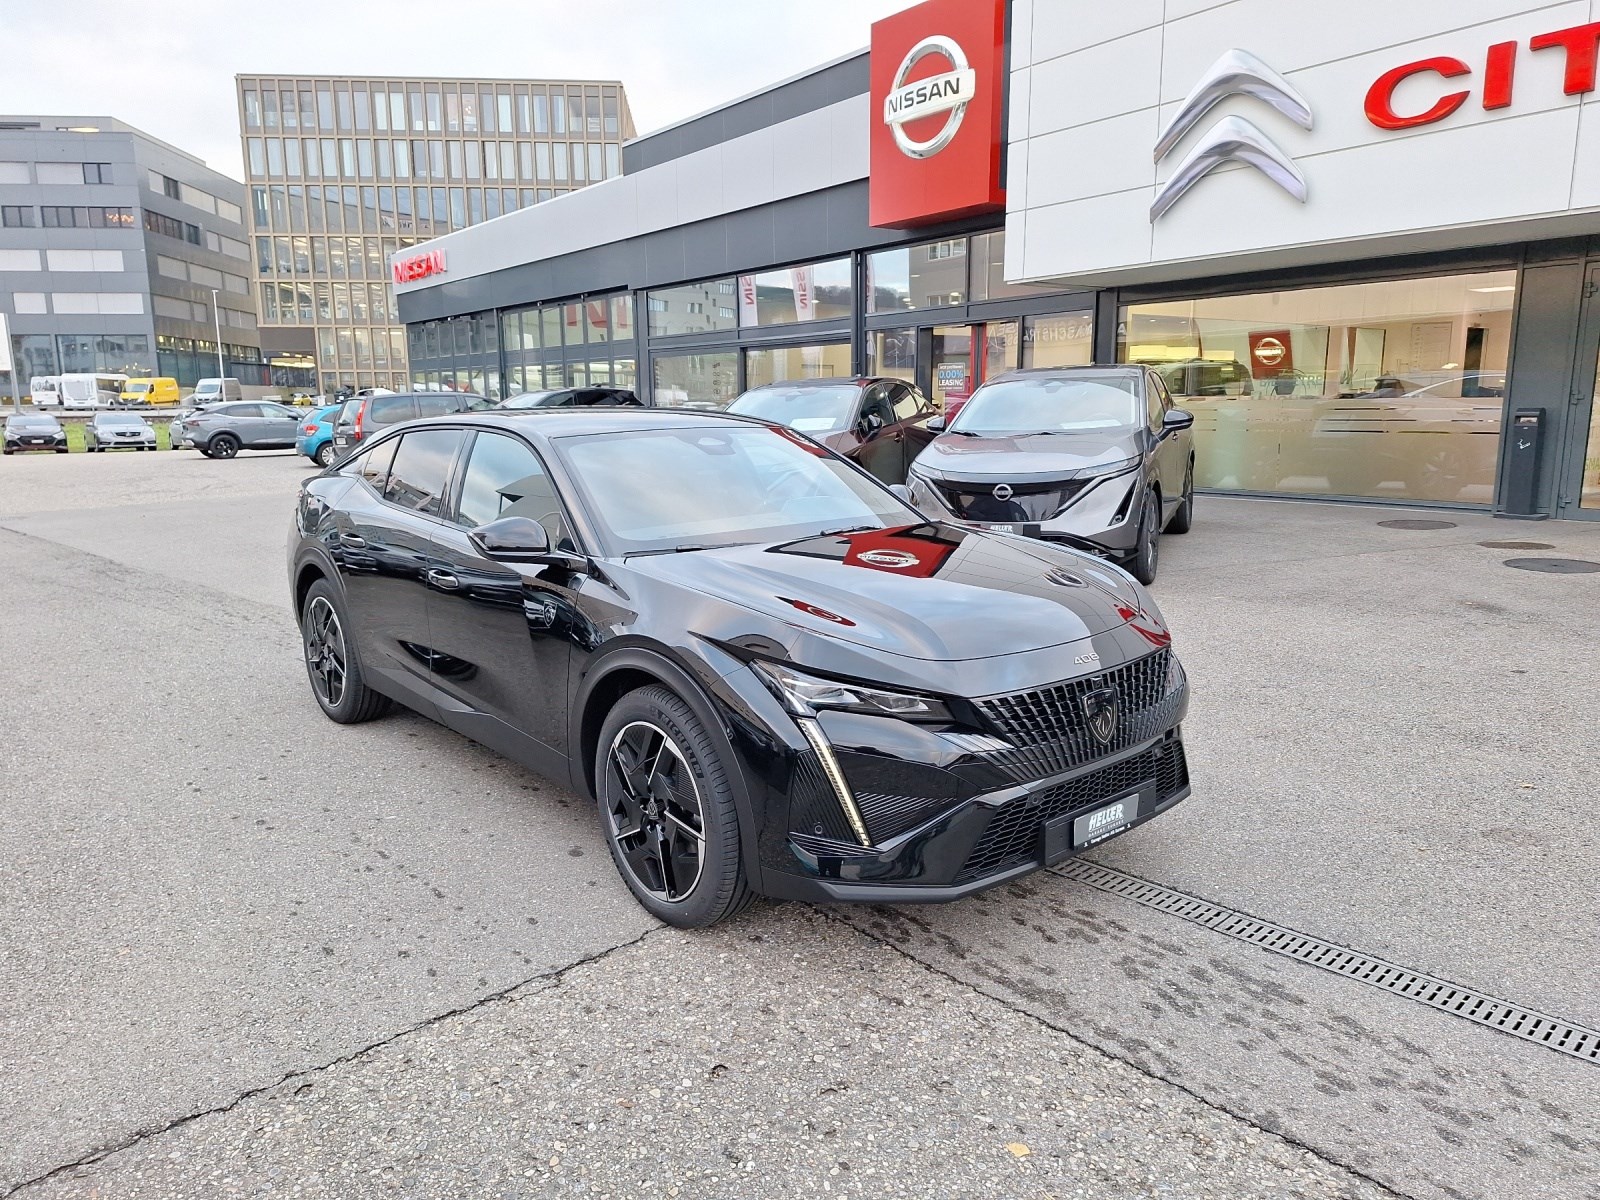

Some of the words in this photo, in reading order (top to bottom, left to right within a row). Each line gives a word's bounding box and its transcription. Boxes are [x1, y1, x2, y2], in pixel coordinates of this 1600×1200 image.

[1364, 22, 1600, 131] CIT
[888, 77, 960, 117] NISSAN
[394, 247, 448, 284] NISSAN
[939, 370, 964, 379] 0.00%
[1074, 652, 1100, 664] 408
[660, 712, 703, 777] MICHELIN
[1089, 803, 1125, 832] HELLER
